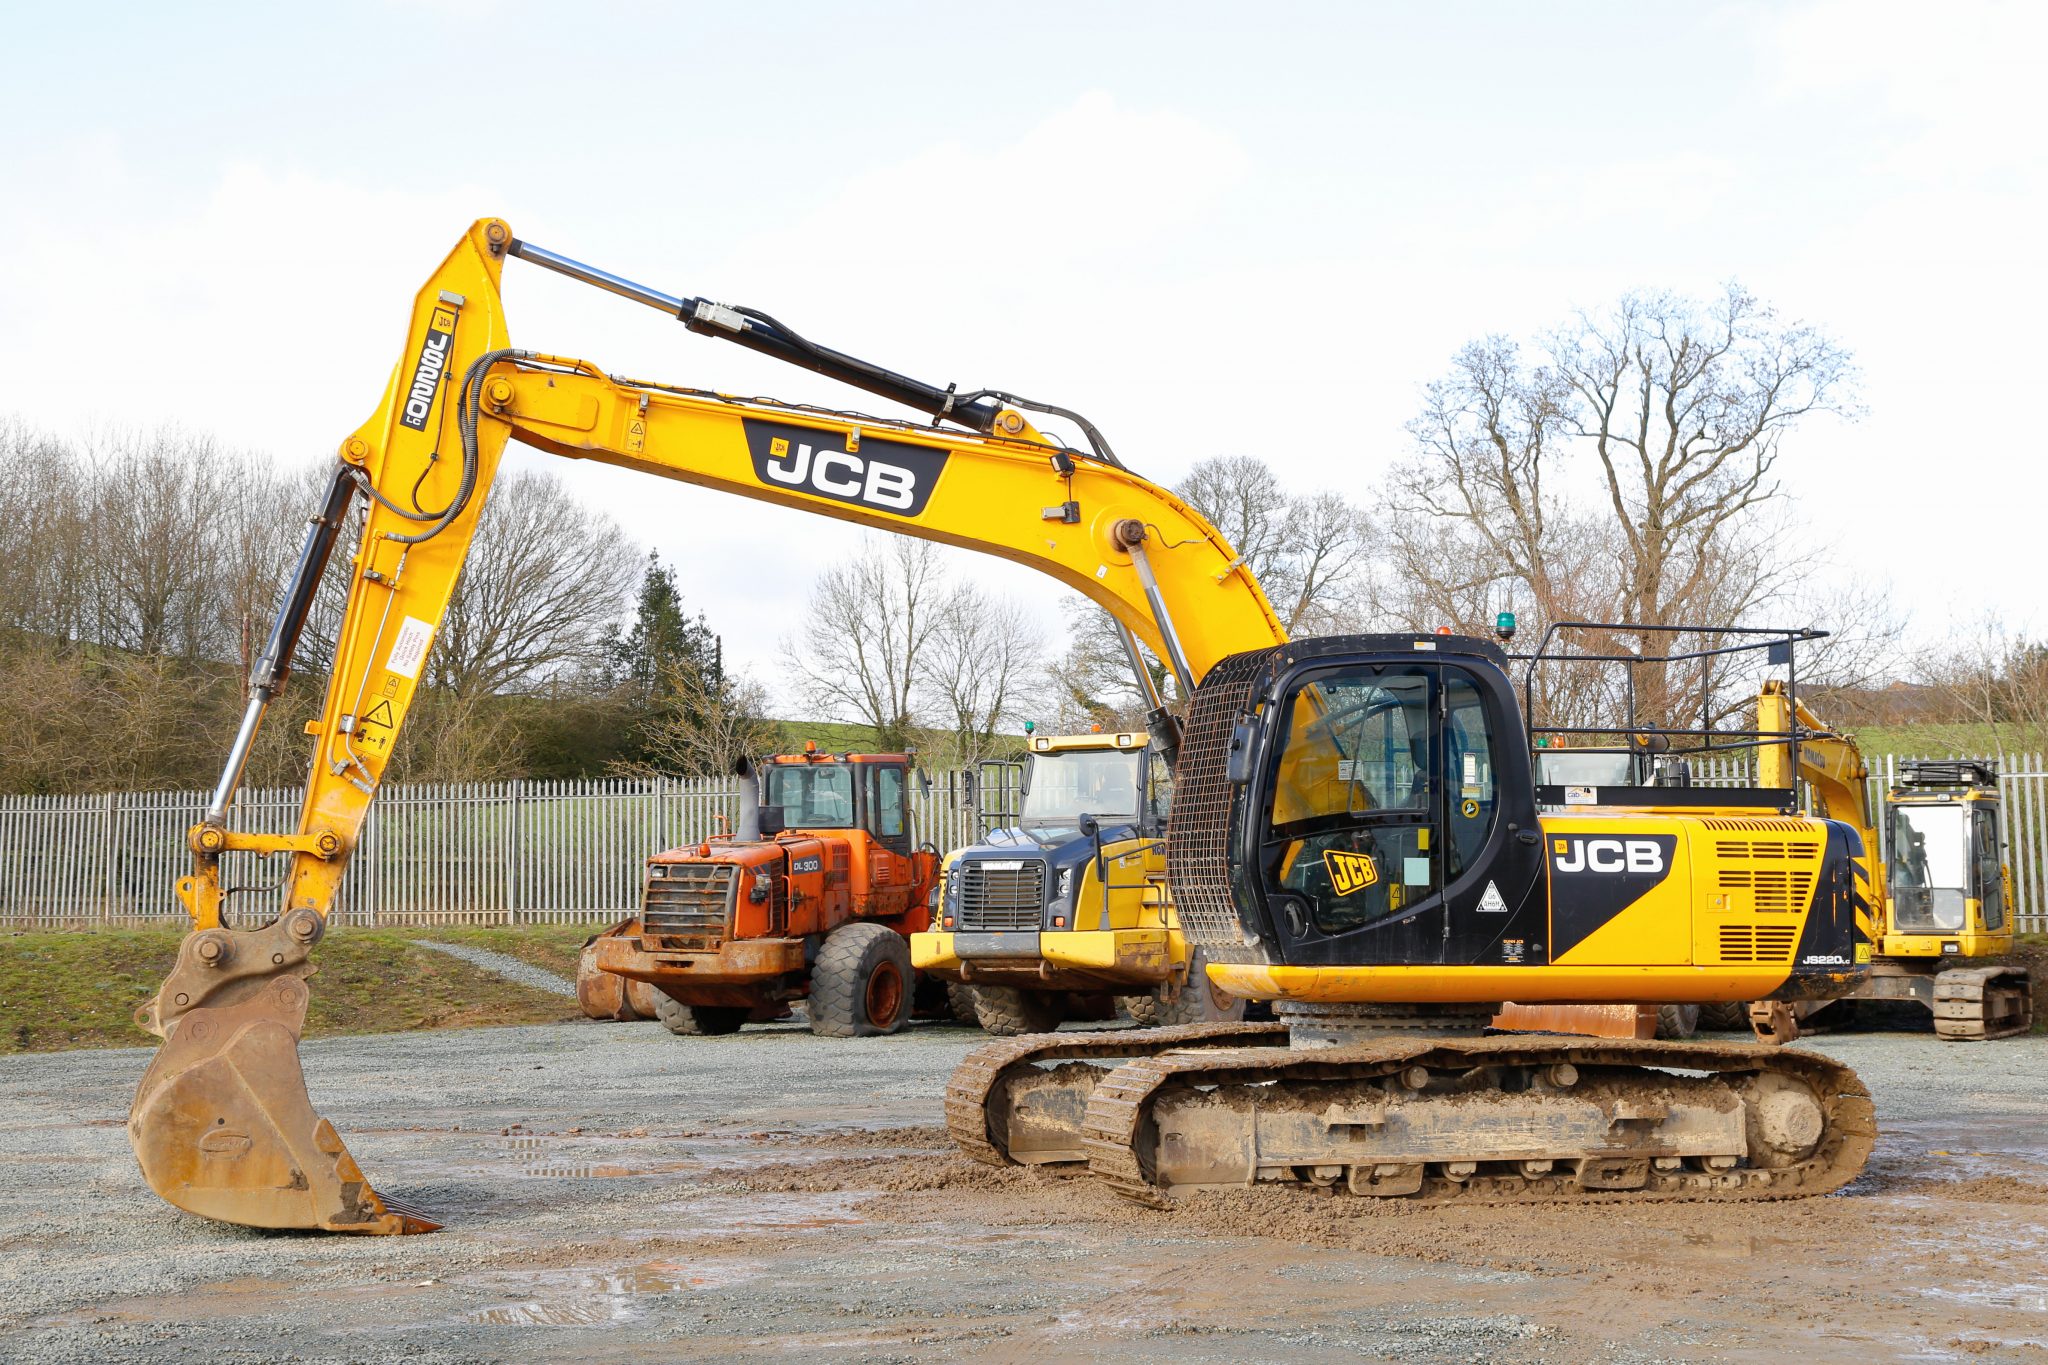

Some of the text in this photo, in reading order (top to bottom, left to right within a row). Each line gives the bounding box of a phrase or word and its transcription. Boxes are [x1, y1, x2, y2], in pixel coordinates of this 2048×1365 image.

[766, 443, 916, 510] JCB
[1333, 854, 1374, 892] JCB
[1555, 839, 1664, 873] JCB
